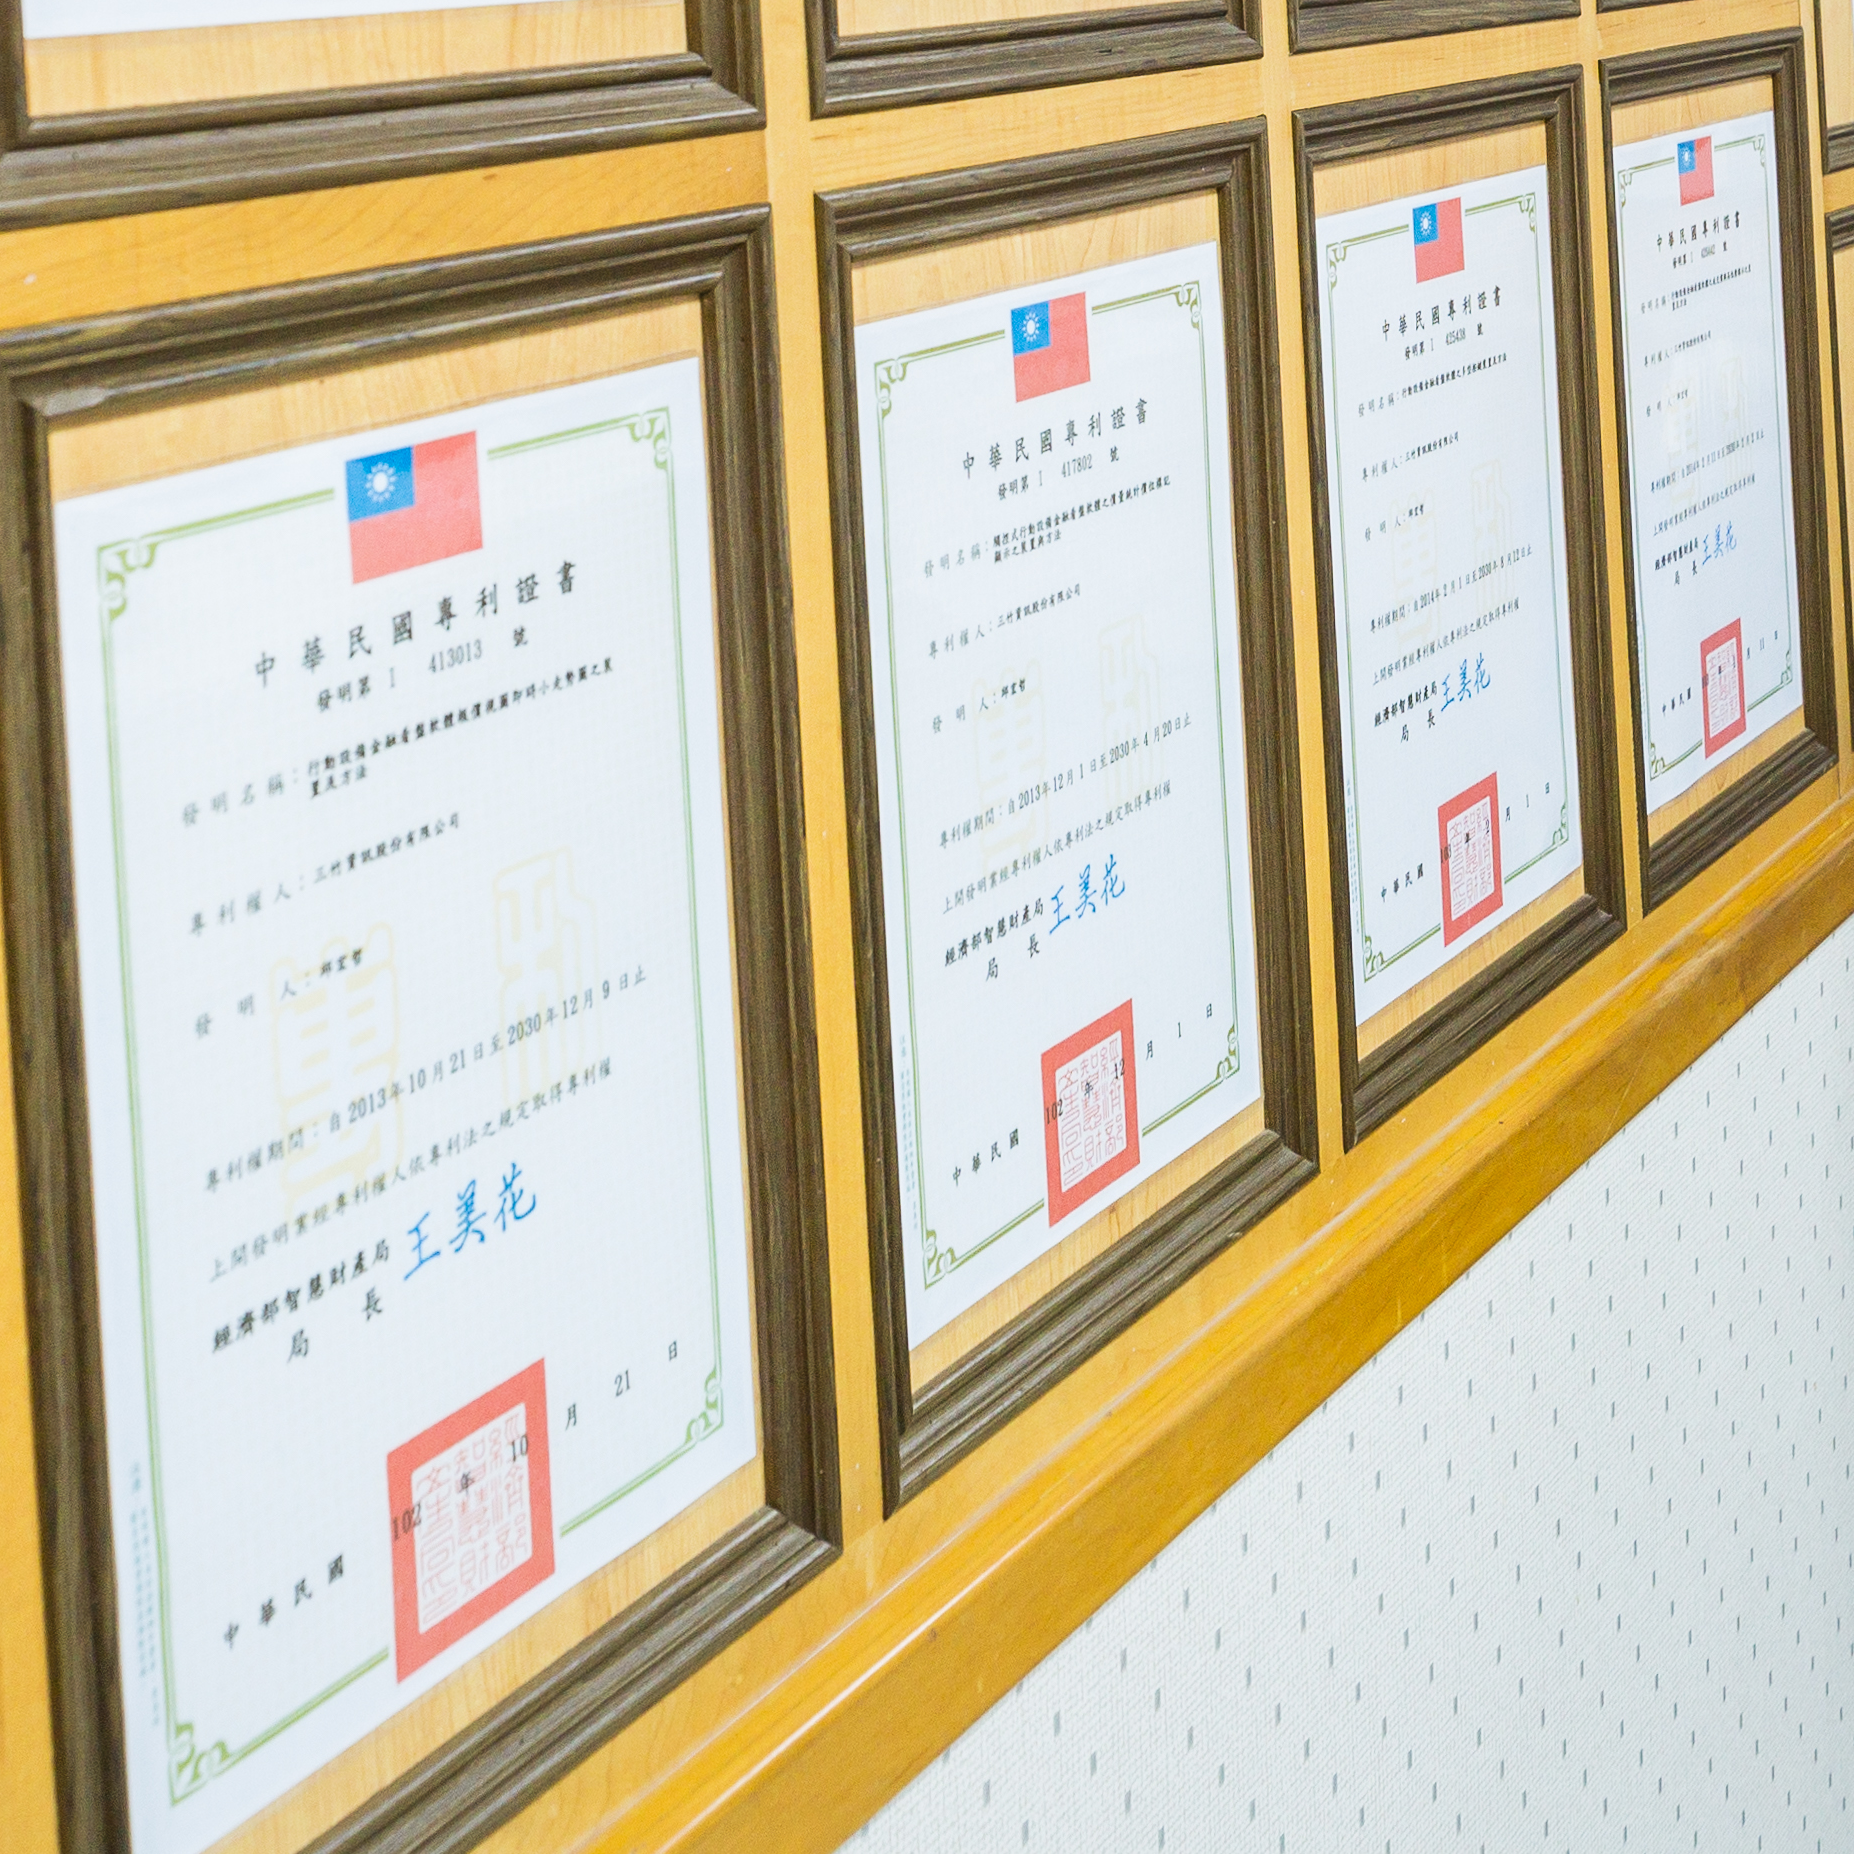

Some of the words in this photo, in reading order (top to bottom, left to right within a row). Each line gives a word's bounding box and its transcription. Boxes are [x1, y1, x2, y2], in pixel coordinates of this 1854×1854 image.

[1381, 284, 1501, 341] 中華民國專利證書
[1403, 339, 1425, 361] 發明第
[1476, 321, 1483, 336] 號
[961, 396, 1148, 479] 中華民國專利證書
[997, 473, 1029, 501] 發明第
[1060, 452, 1093, 478] 417802
[1109, 444, 1119, 463] 號
[254, 559, 576, 687] 中華民國專利證書
[996, 582, 1080, 628] 三竹資訊股份有限公司
[316, 674, 371, 713] 發明第
[427, 637, 483, 674] 413013
[512, 624, 528, 648] 號
[1373, 679, 1437, 727] 經濟部智慧財產局
[1439, 651, 1491, 712] 王美花
[315, 811, 459, 883] 三竹資訊股份有限公司
[944, 896, 1044, 967] 經濟部智慧財產局
[1048, 852, 1126, 935] 王美花
[951, 1127, 1019, 1186] 中華民國
[1043, 1096, 1065, 1125] 102
[1145, 1039, 1154, 1060] 月
[1176, 1020, 1182, 1039] 1
[1205, 1002, 1213, 1019] 日
[402, 1161, 537, 1281] 王美花
[212, 1237, 389, 1353] 經濟部智慧財產局
[222, 1552, 344, 1649] 中華民國
